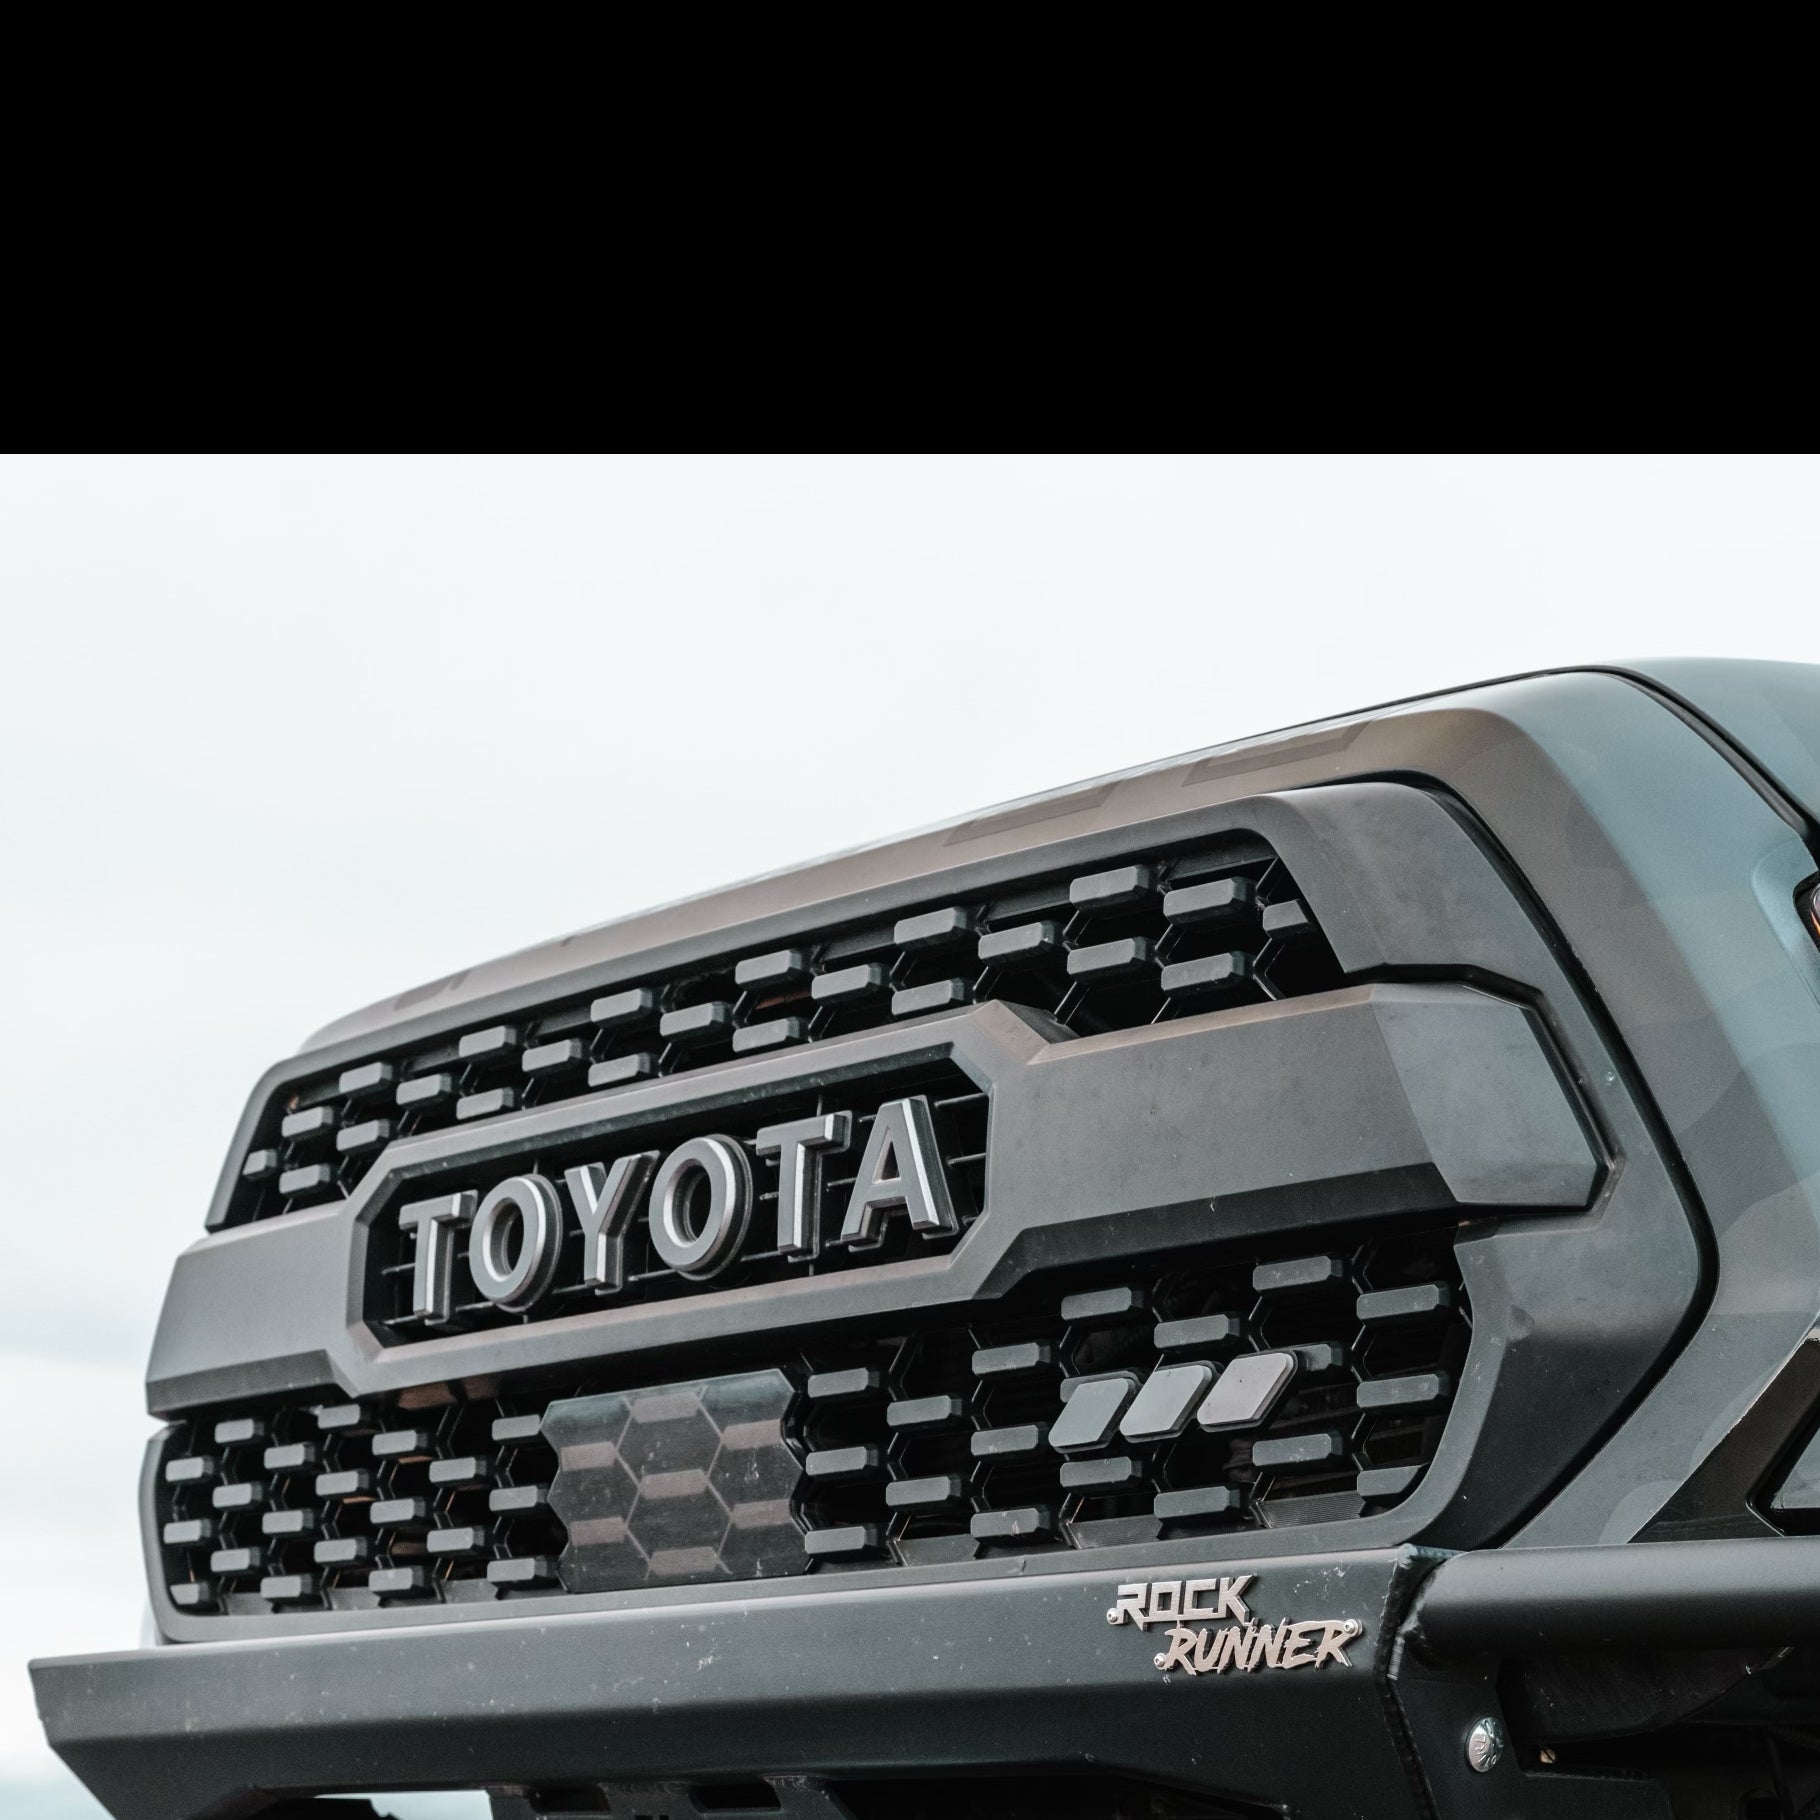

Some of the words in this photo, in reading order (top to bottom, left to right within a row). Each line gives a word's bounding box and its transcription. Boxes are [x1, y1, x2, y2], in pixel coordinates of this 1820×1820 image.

[399, 1094, 958, 1326] TOYOTA
[1112, 1574, 1256, 1631] ROCK
[1161, 1617, 1358, 1676] RUNNER
